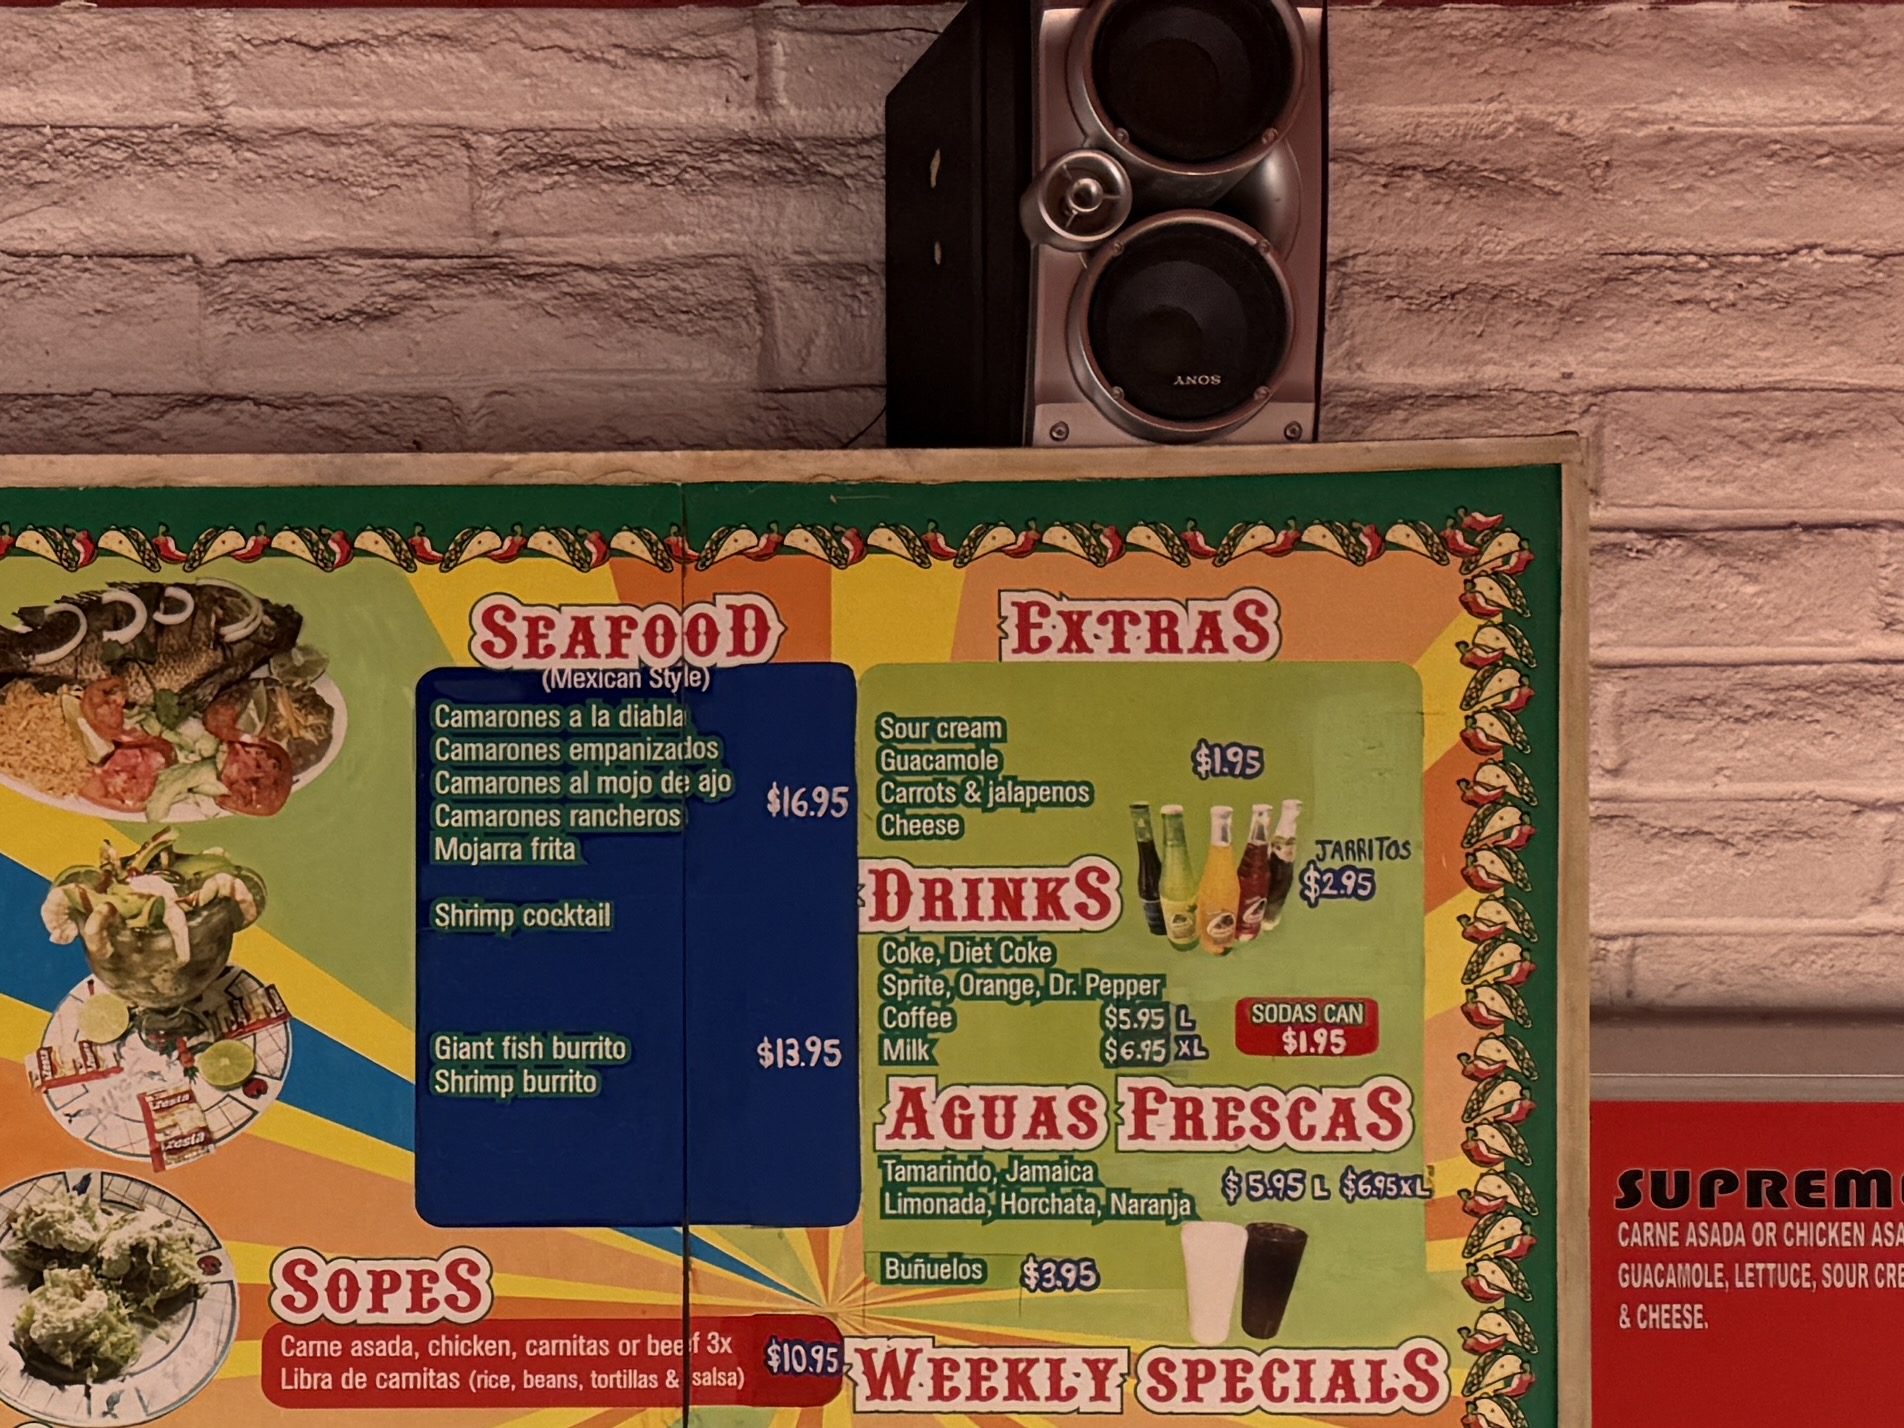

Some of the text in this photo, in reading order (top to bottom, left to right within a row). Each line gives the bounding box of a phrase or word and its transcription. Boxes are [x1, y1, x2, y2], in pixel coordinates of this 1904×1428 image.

[1174, 375, 1221, 385] SONY
[481, 604, 771, 660] SEAFOOD
[1011, 600, 1271, 654] EXTRAS
[880, 717, 1002, 740] Sour cream
[880, 749, 998, 771] Guacamole
[1195, 743, 1260, 775] $1.95
[768, 783, 849, 819] $16.95
[1315, 839, 1411, 862] JARRITOS
[869, 867, 1113, 921] DRINKS
[1303, 868, 1373, 903] $2.95
[436, 904, 611, 929] Shrimp cocktail
[1251, 1004, 1363, 1024] SODAS CAN
[436, 1036, 842, 1069] Giant fish burrito $13.95
[884, 1040, 929, 1061] Milk
[1282, 1029, 1346, 1055] $1.95
[886, 1087, 1403, 1142] AGUAS FRESCAS
[281, 1259, 484, 1314] SOPES
[886, 1258, 1096, 1289] Buñuelos $3.95
[1618, 1263, 1817, 1292] GUACAMOLE, LETTUCE,
[1619, 1304, 1708, 1329] & CHEESE.
[855, 1348, 1439, 1403] WEEKLY SPECIALS
